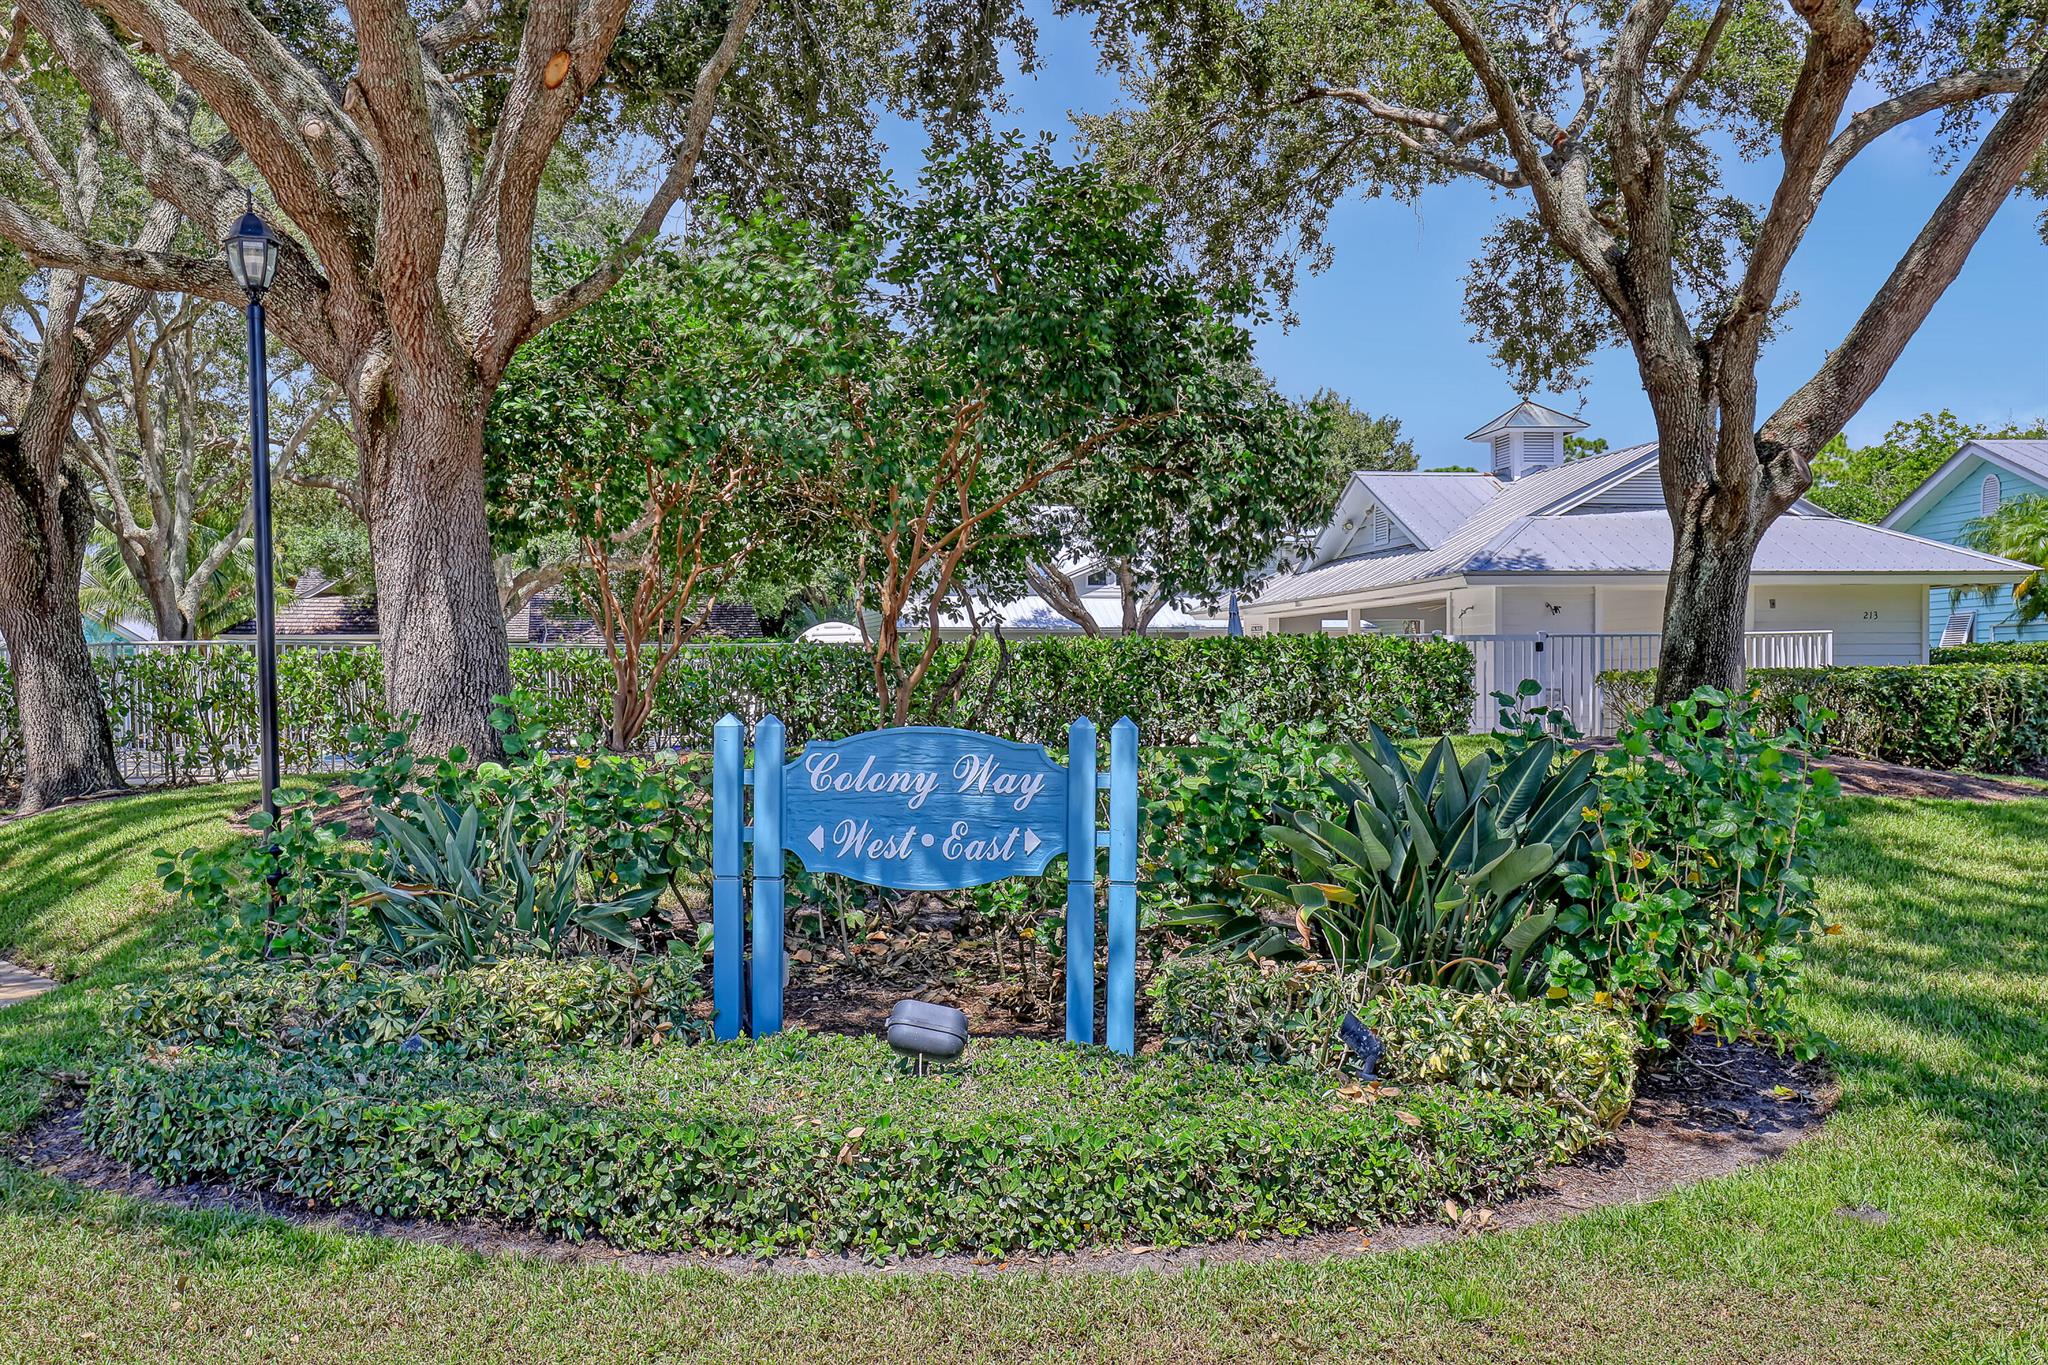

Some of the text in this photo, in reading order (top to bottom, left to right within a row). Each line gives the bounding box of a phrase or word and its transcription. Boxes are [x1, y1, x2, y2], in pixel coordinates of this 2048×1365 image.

[1863, 611, 1879, 620] 213
[805, 752, 1045, 811] Colony Way
[832, 818, 1020, 861] West East
